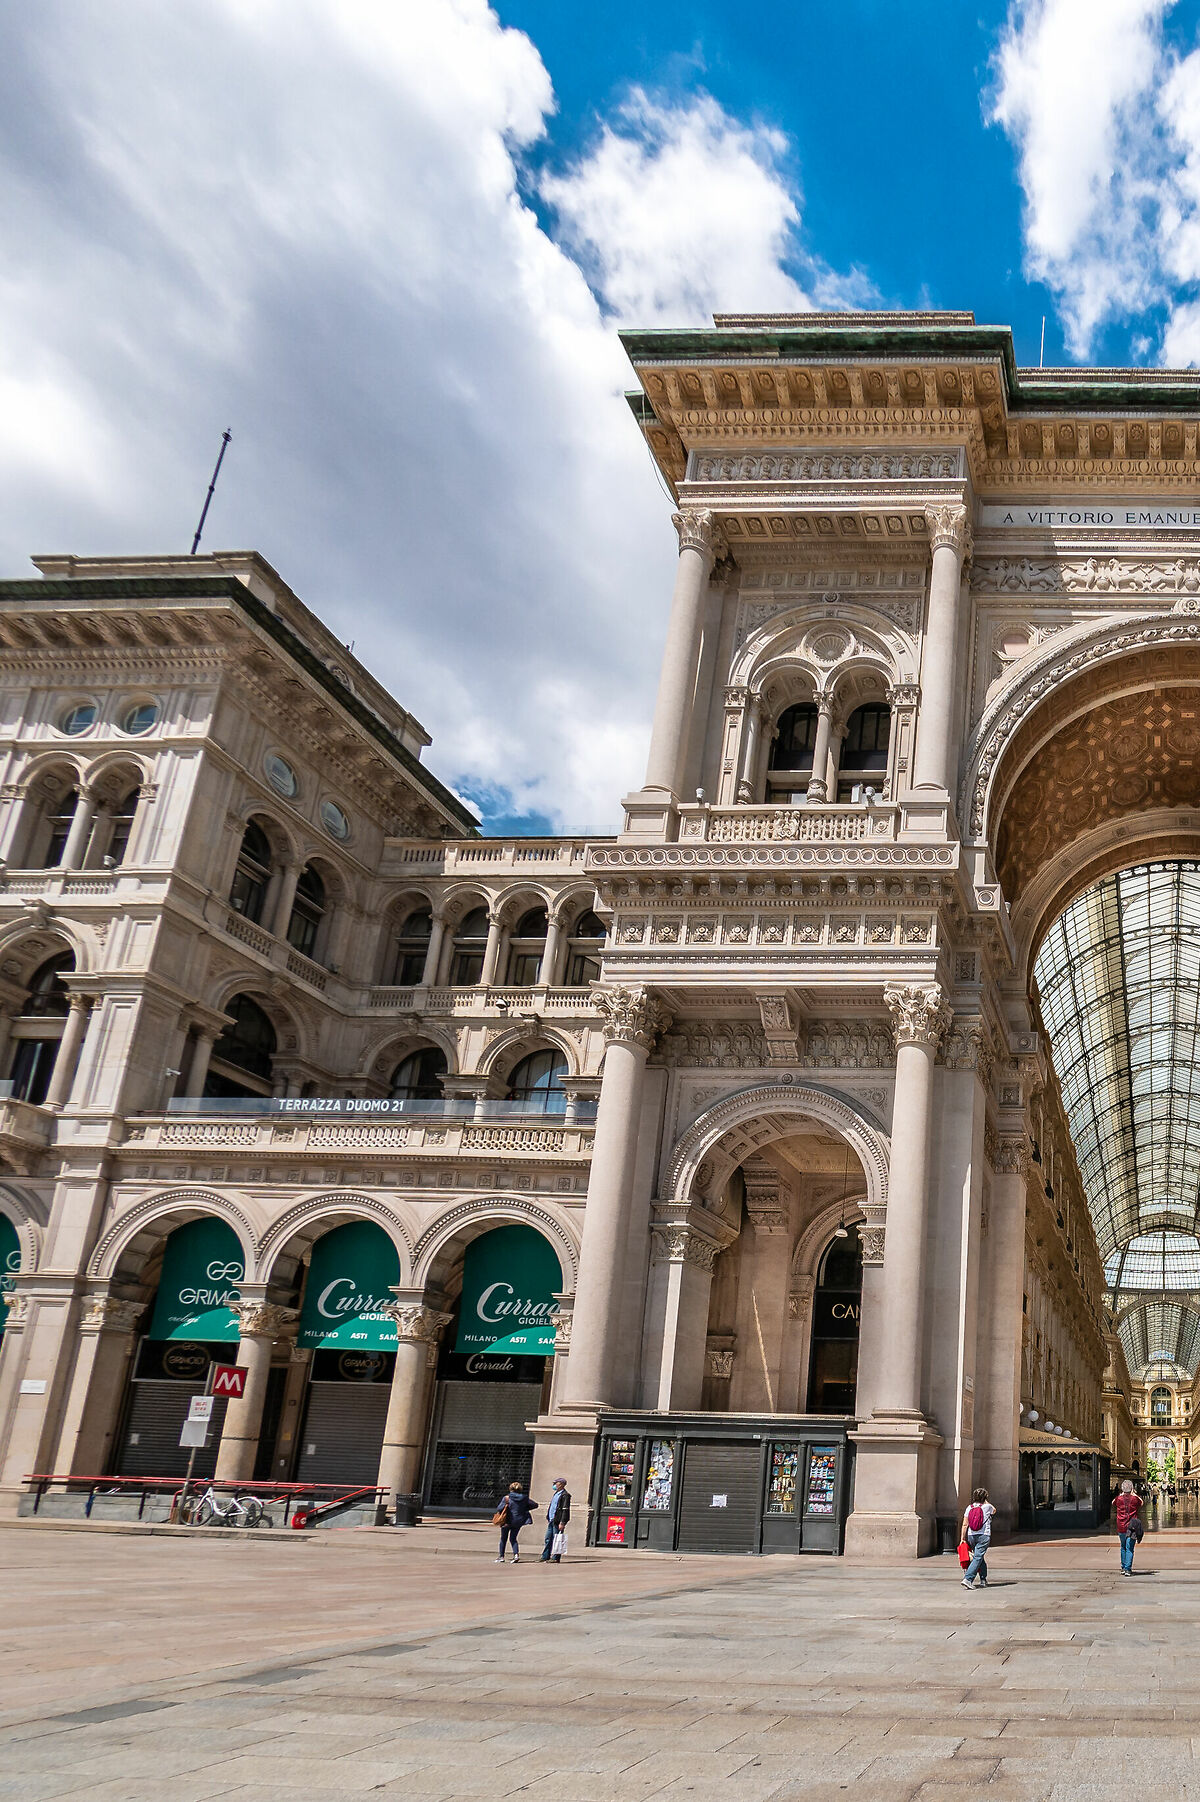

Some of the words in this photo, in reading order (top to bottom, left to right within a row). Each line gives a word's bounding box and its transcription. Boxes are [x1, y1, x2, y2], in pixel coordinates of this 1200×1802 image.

[1003, 512, 1014, 524] A
[1027, 512, 1114, 524] VITTORIO
[279, 1100, 341, 1111] TERRAZZA
[346, 1100, 390, 1112] DUOMO
[391, 1101, 404, 1112] 21
[304, 1330, 340, 1339] MILANO
[350, 1332, 368, 1340] ASTI
[464, 1334, 498, 1343] MILANO
[509, 1336, 527, 1344] ASTI
[465, 1353, 514, 1374] Currado
[214, 1371, 242, 1392] M
